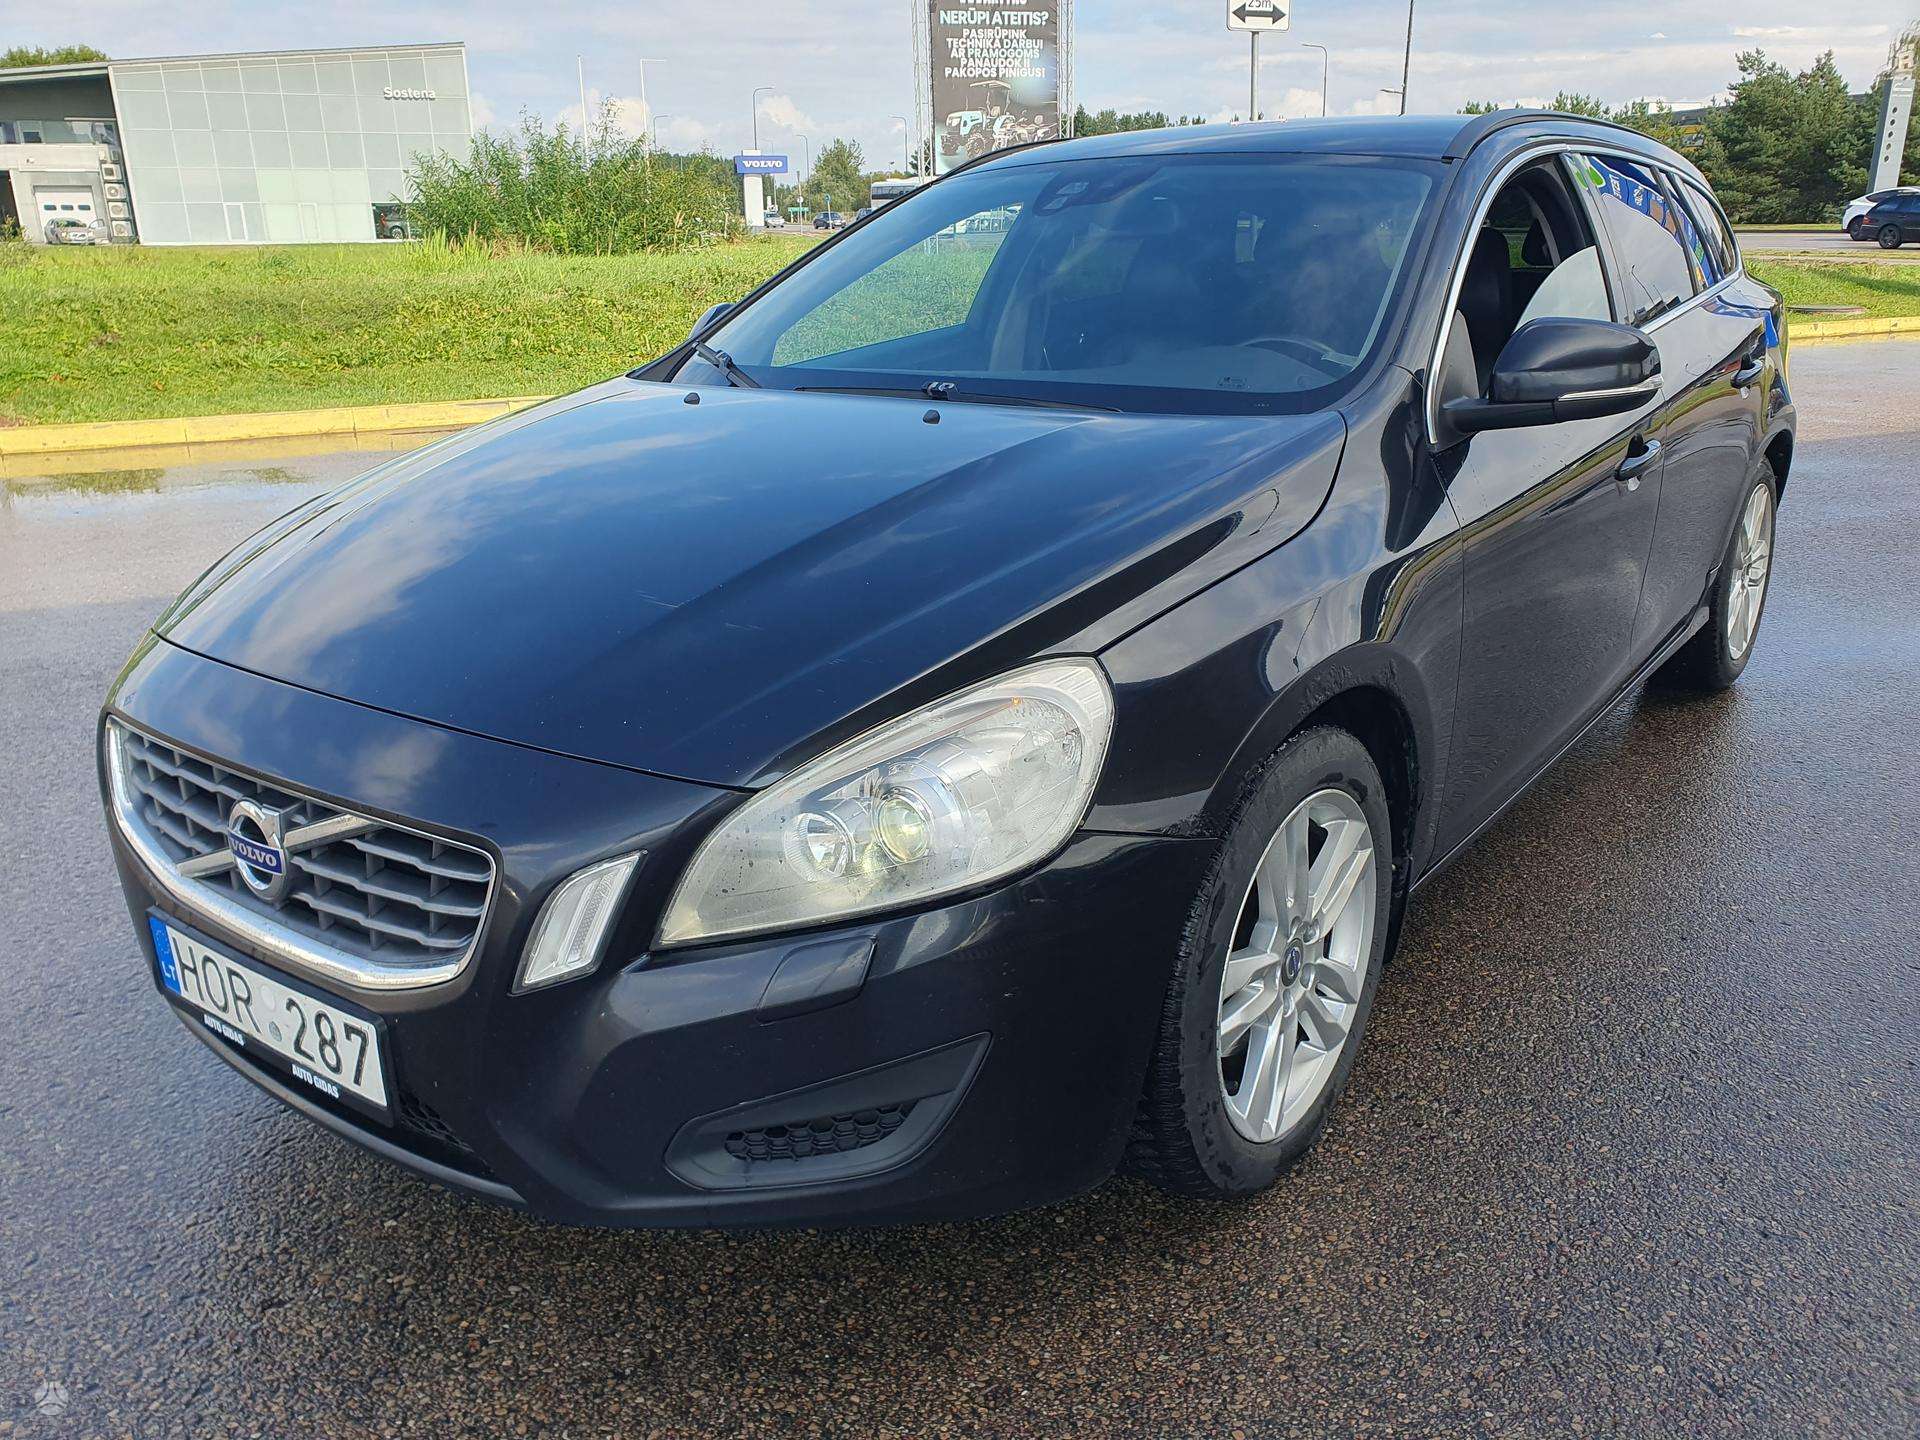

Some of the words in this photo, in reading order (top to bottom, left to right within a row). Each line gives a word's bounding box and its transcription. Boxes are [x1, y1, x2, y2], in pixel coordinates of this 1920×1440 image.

[940, 7, 990, 25] NERŪPI
[991, 11, 1049, 26] ATEITIS?
[962, 26, 1027, 39] PASIRŪPINK
[946, 38, 1001, 49] TECHNIKA
[1003, 39, 1044, 49] DARBUI
[950, 48, 966, 59] AR
[967, 48, 1040, 59] PRAMOGOMS
[960, 58, 1022, 68] PANAUDOK
[944, 67, 997, 78] PAKOPOS
[384, 86, 436, 99] Sostena
[743, 160, 783, 168] VOLVO
[229, 837, 277, 867] VOLVO
[161, 961, 177, 980] LT
[172, 936, 262, 1034] HOR
[285, 997, 370, 1087] 287
[203, 1014, 223, 1033] AUTO
[221, 1024, 246, 1047] GIDAS
[292, 1063, 313, 1085] AUTO
[312, 1075, 340, 1099] GIDAS
